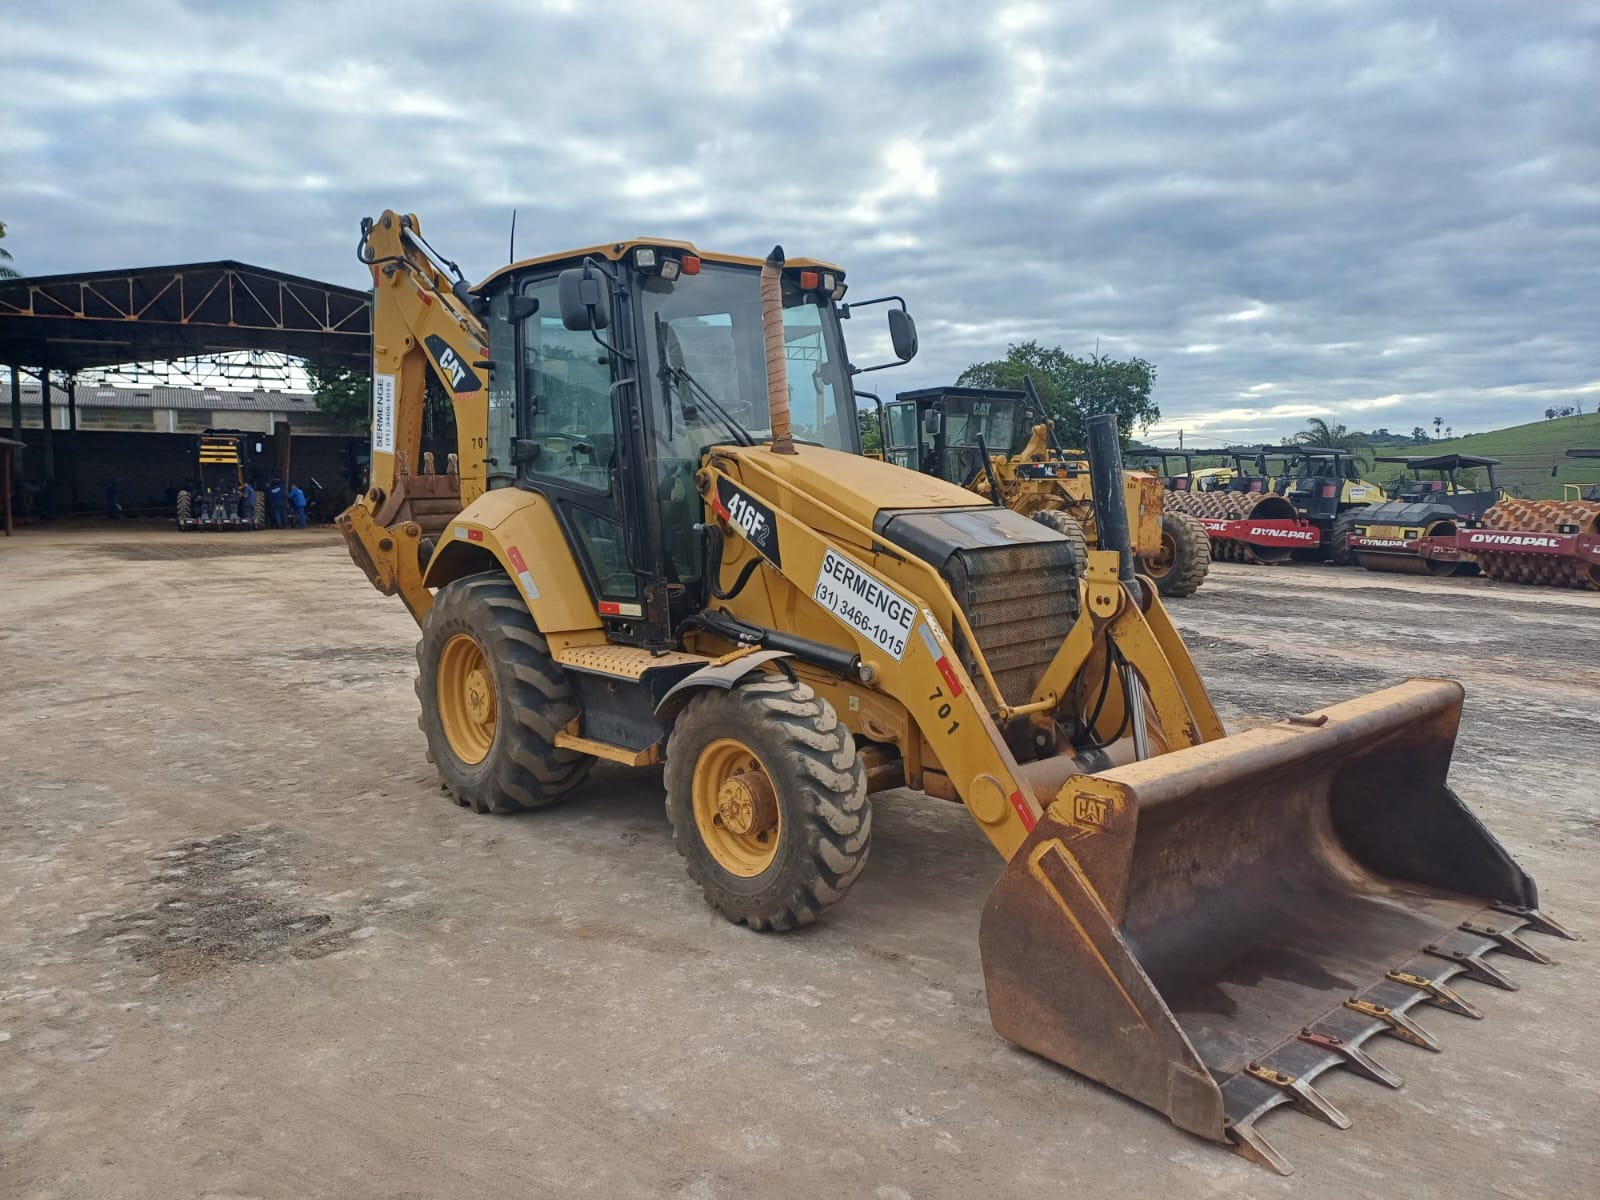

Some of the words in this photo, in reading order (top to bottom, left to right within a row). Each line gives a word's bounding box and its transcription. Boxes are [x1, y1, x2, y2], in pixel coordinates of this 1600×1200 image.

[439, 347, 466, 388] CAT
[376, 378, 384, 447] SERMENGE
[973, 402, 992, 416] CAT
[1250, 527, 1315, 540] DYNAPAC
[1471, 534, 1562, 547] DYNAPAC
[823, 554, 914, 630] SERMENGE
[815, 582, 839, 611] (31)
[839, 600, 904, 655] 3466-1015
[929, 686, 960, 735] 701
[1075, 798, 1108, 824] CAT
